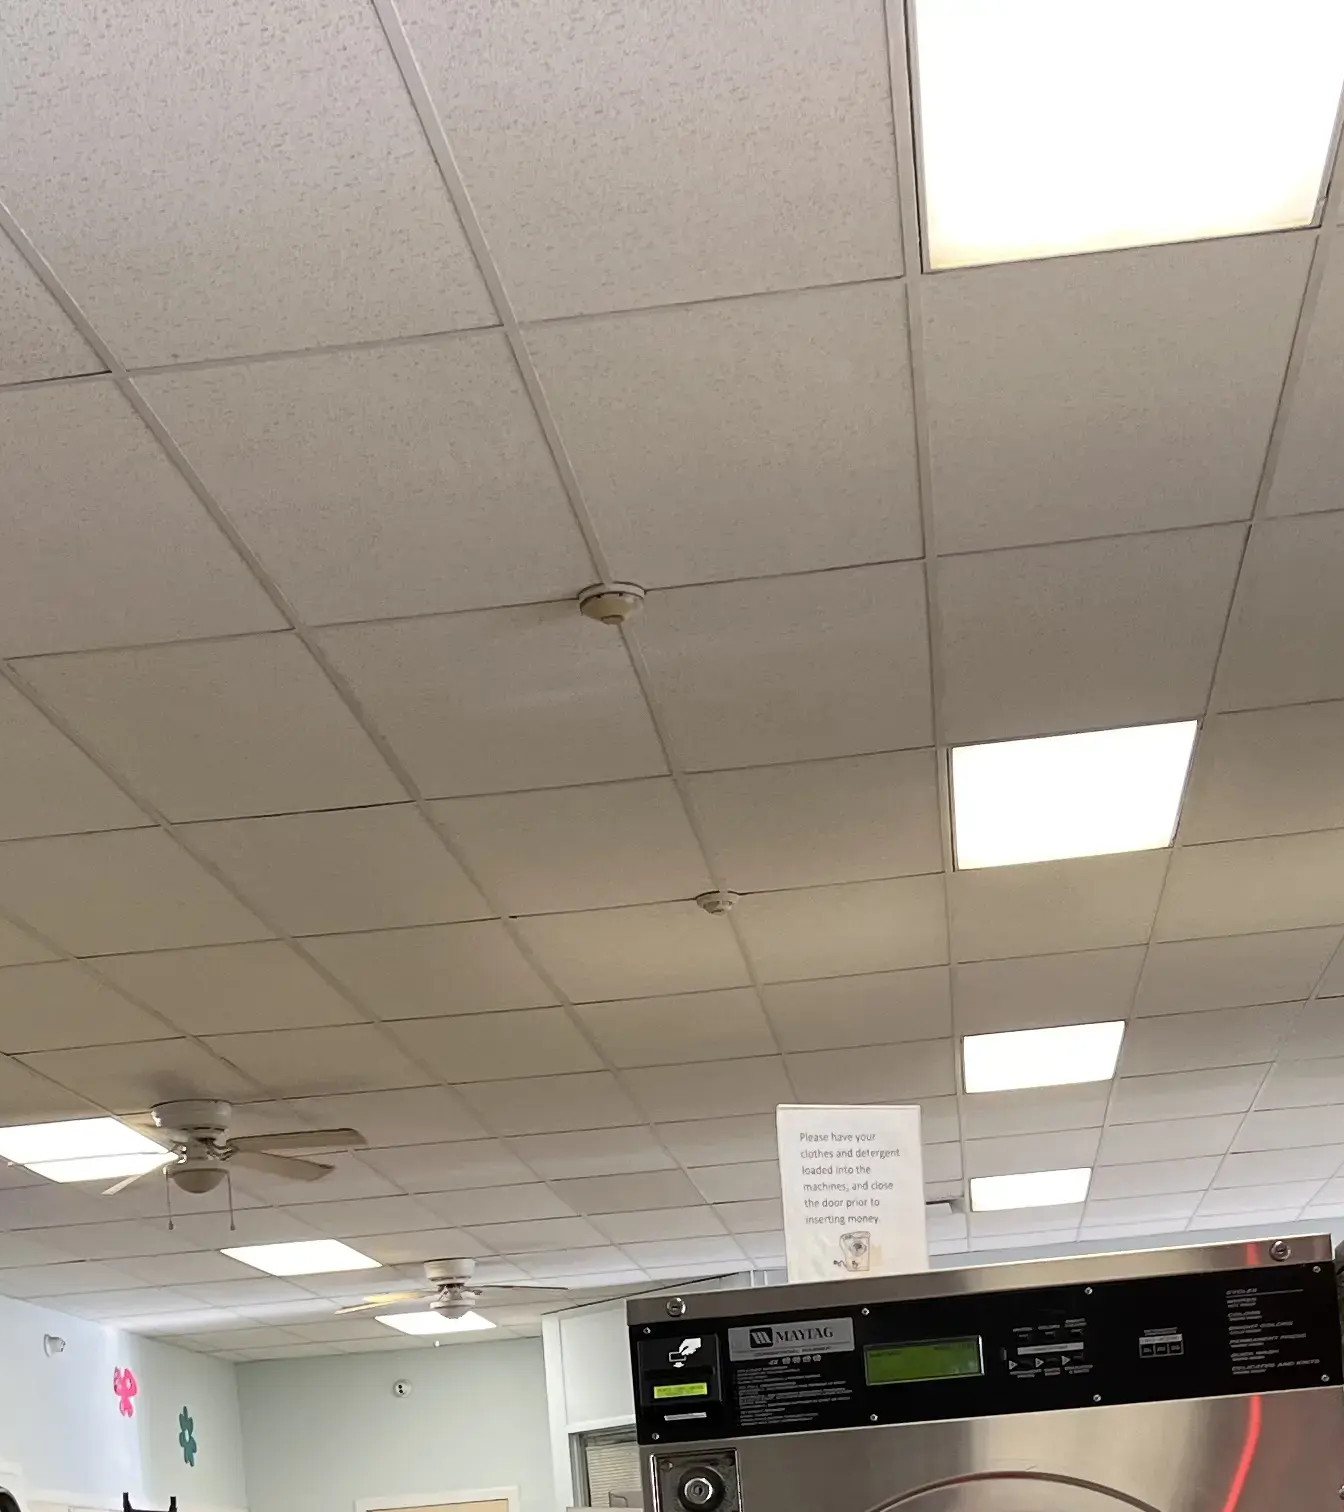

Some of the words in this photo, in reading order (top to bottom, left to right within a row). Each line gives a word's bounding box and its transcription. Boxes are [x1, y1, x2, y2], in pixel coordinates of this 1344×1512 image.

[800, 1132, 828, 1142] Please
[831, 1132, 853, 1142] have
[855, 1133, 876, 1143] your
[800, 1149, 834, 1158] clothes
[836, 1148, 852, 1158] and
[856, 1148, 900, 1160] detergent
[802, 1165, 832, 1174] loaded
[836, 1165, 854, 1174] into
[856, 1164, 871, 1174] the
[803, 1182, 849, 1192] machines,
[852, 1181, 868, 1190] and
[870, 1181, 894, 1190] close
[804, 1198, 820, 1208] the
[822, 1198, 844, 1208] door
[846, 1198, 868, 1210] prior
[870, 1198, 880, 1206] to
[806, 1216, 846, 1226] inserting
[776, 1327, 834, 1342] MAYTAG
